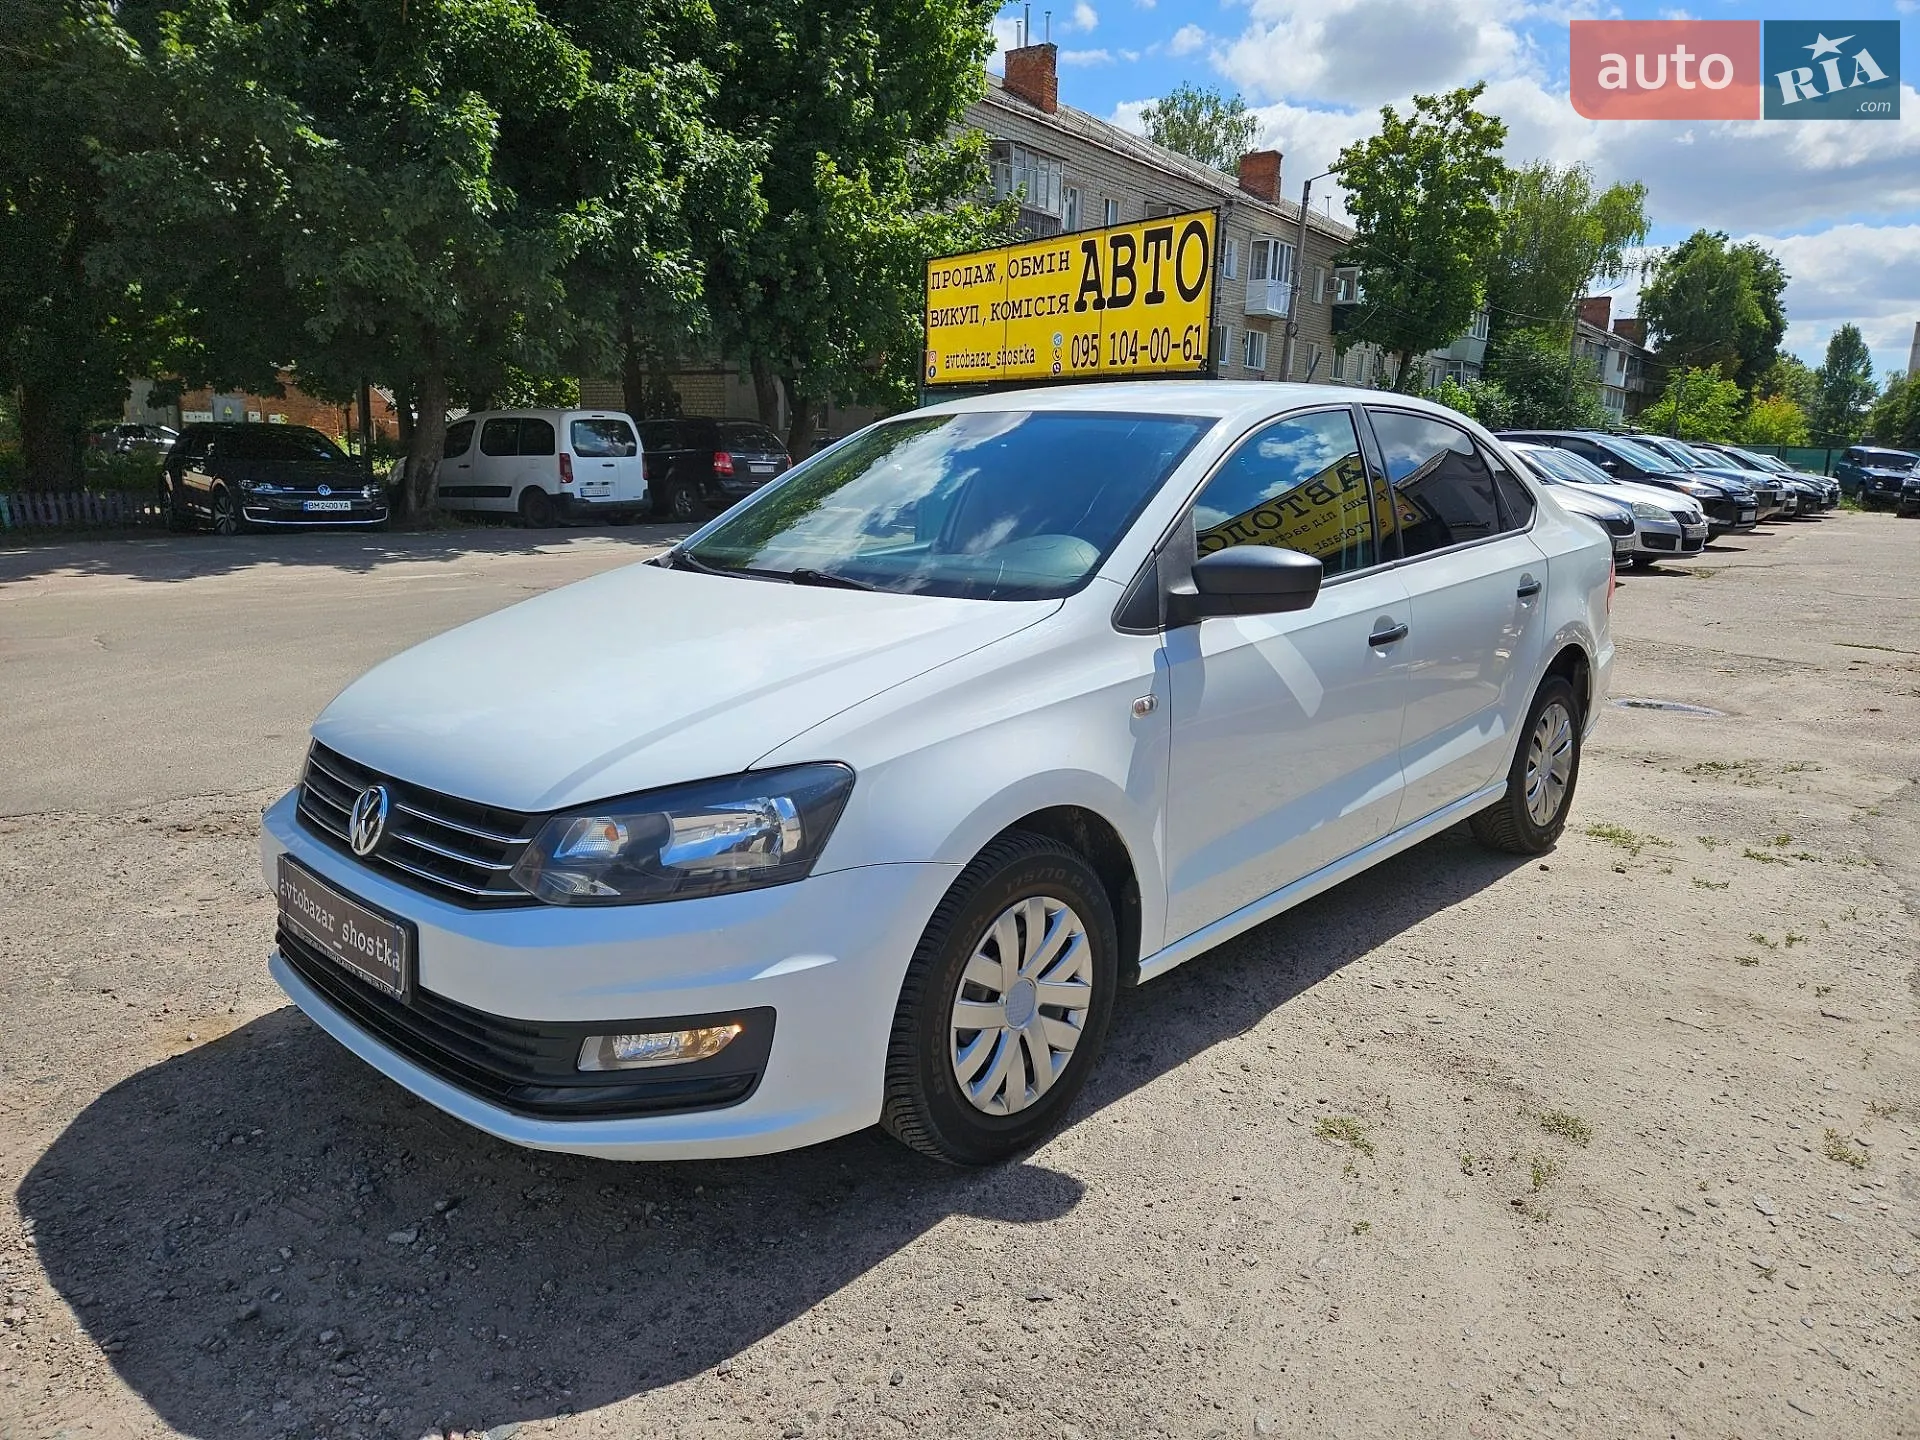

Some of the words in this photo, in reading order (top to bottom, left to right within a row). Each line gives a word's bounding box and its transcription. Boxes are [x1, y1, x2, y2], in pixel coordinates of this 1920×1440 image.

[1074, 220, 1210, 312] АВТО
[1071, 333, 1099, 368] 095
[1109, 324, 1203, 366] 104-00-61
